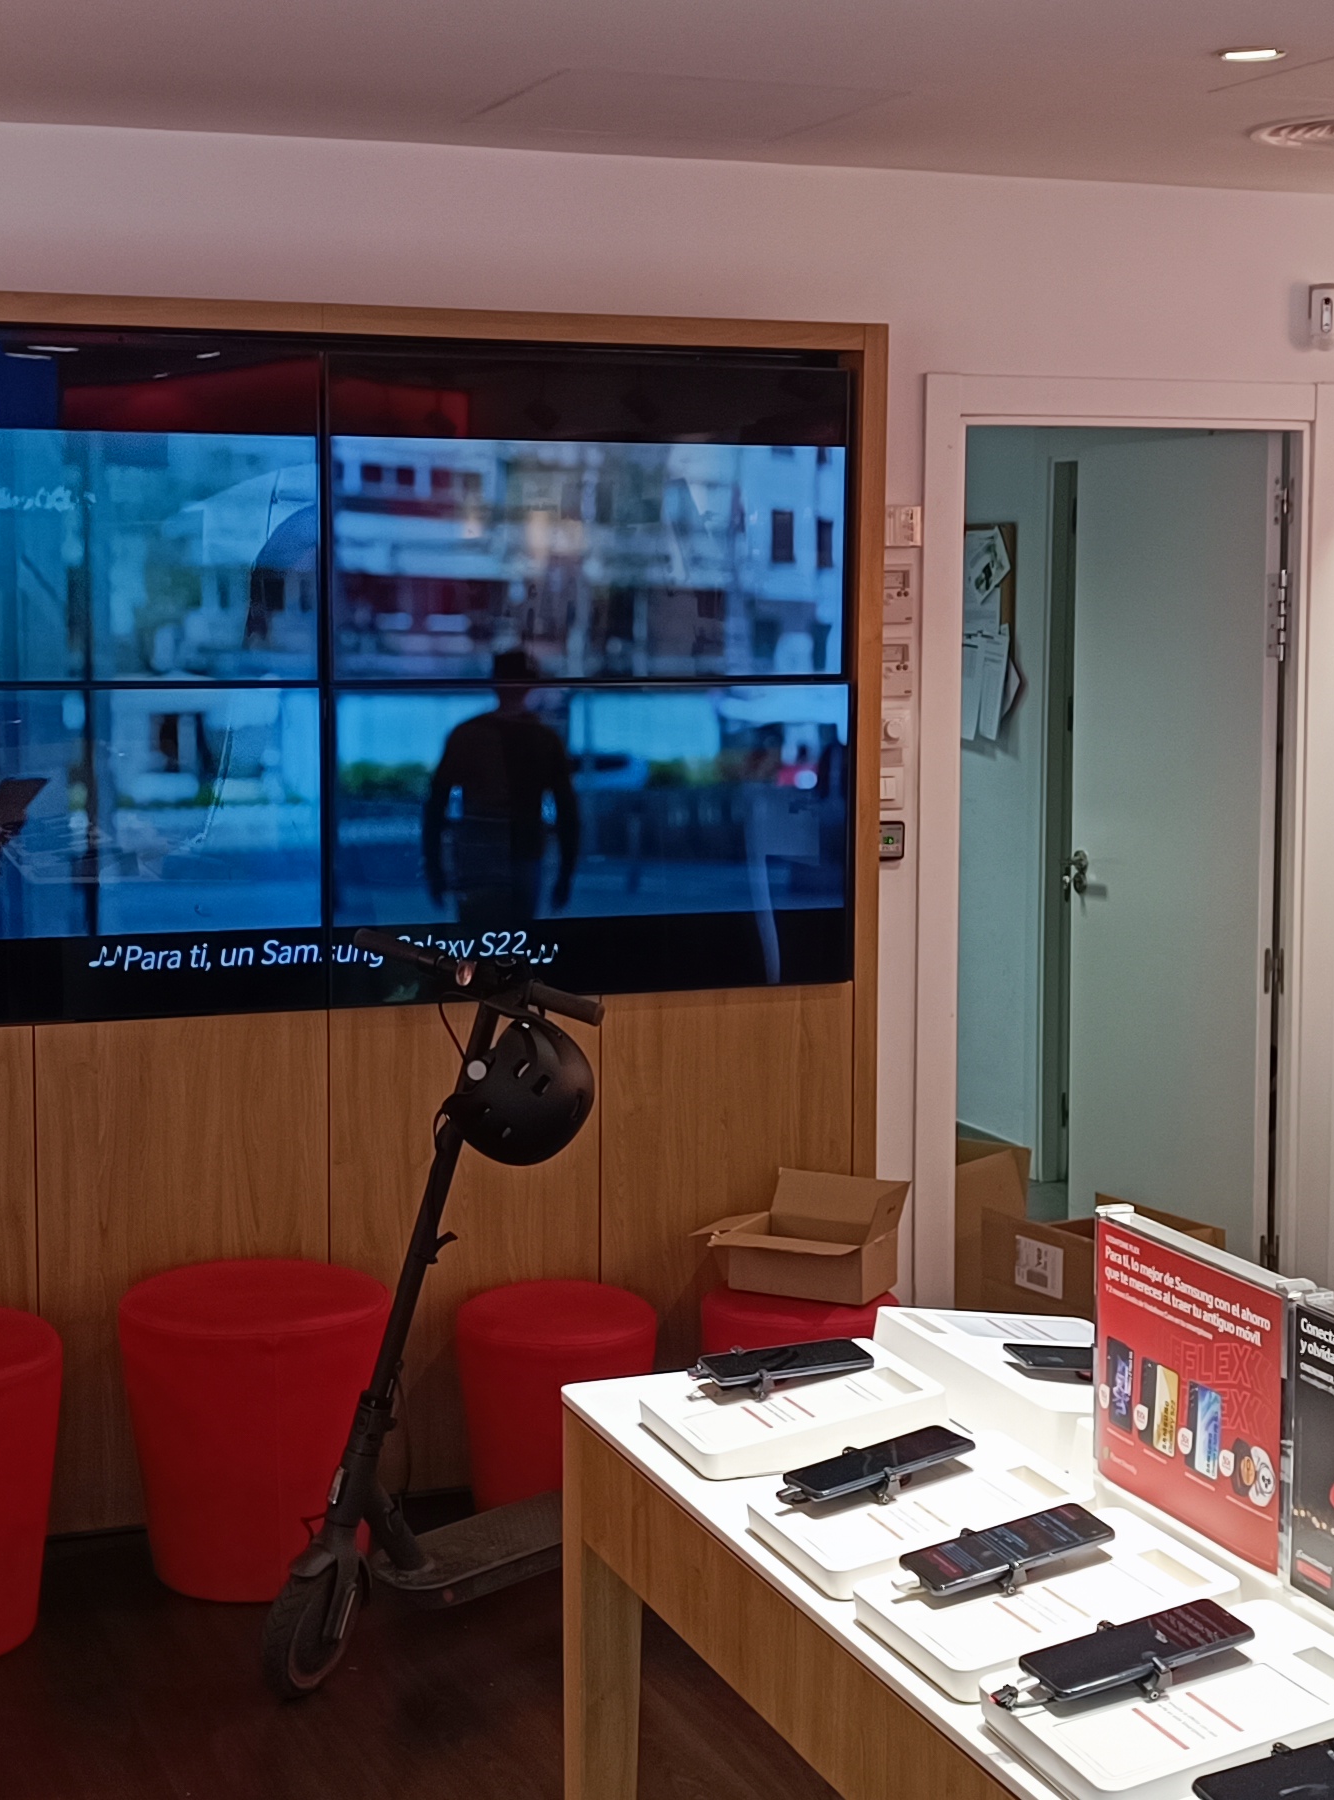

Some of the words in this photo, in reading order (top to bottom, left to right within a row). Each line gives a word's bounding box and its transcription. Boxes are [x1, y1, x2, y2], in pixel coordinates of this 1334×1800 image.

[124, 944, 182, 972] Para
[190, 942, 212, 972] ti,
[220, 945, 255, 966] un
[261, 939, 384, 968] Samung
[396, 934, 474, 958] laxy
[1104, 1265, 1120, 1282] que
[1120, 1271, 1129, 1286] te
[1128, 1276, 1163, 1301] mereces
[1162, 1291, 1172, 1306] al
[1171, 1294, 1193, 1315] traer
[1192, 1303, 1202, 1319] tu
[1202, 1310, 1235, 1335] antiguo
[1235, 1325, 1262, 1347] móvil
[1105, 1245, 1123, 1265] Para
[1130, 1256, 1139, 1272] lo
[1139, 1265, 1164, 1283] mejor
[1163, 1272, 1175, 1288] de
[1174, 1276, 1214, 1309] Samsung
[1214, 1297, 1230, 1313] con
[1231, 1302, 1240, 1318] el
[1241, 1307, 1271, 1331] ahorro
[1299, 1338, 1308, 1356] y
